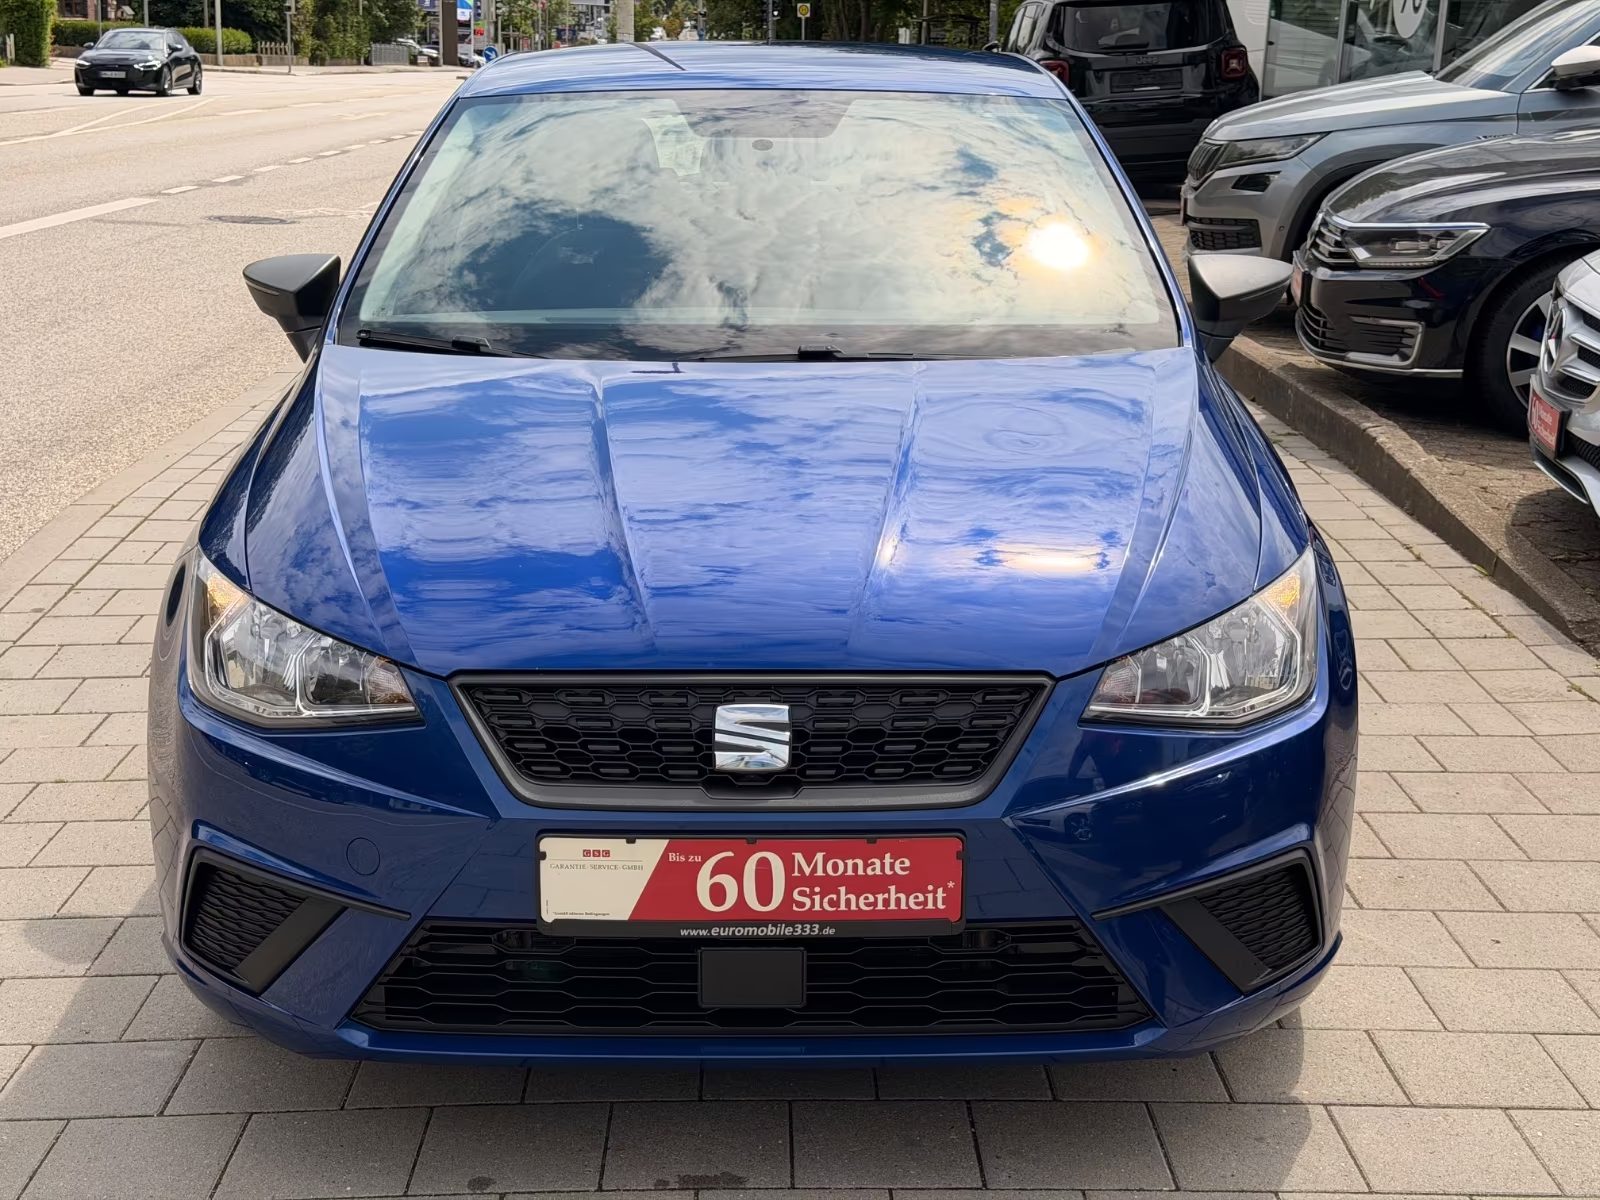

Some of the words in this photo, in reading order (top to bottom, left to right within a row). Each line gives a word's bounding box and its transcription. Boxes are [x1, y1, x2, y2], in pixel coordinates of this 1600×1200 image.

[792, 852, 911, 876] Monate
[668, 852, 685, 862] Bis
[688, 854, 702, 862] zu
[696, 851, 786, 912] 60
[680, 923, 836, 937] www.euromobile333.de
